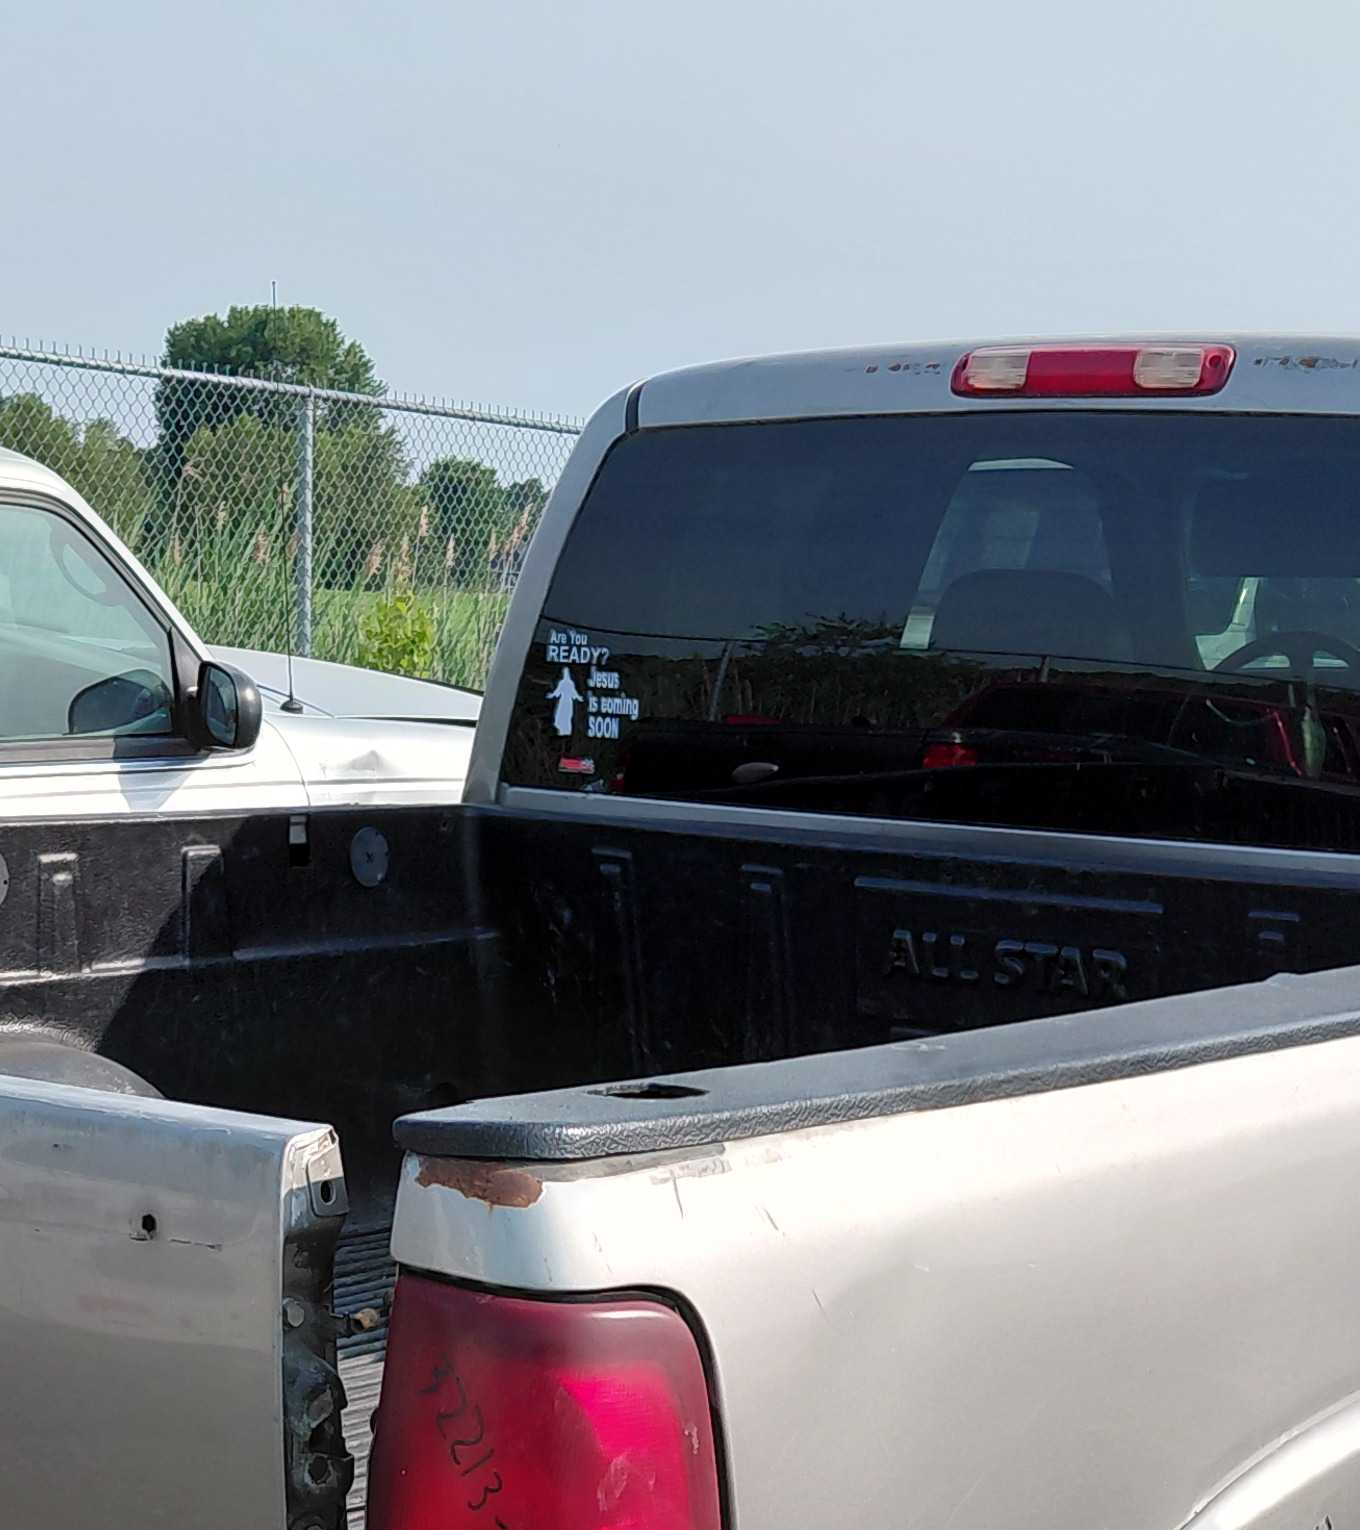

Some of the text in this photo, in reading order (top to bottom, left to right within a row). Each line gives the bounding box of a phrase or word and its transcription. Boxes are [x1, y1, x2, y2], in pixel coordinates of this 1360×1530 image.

[550, 629, 587, 645] Are You
[547, 646, 609, 665] READY?
[589, 668, 620, 689] Jesus
[600, 697, 639, 720] coming
[588, 718, 619, 739] SOON
